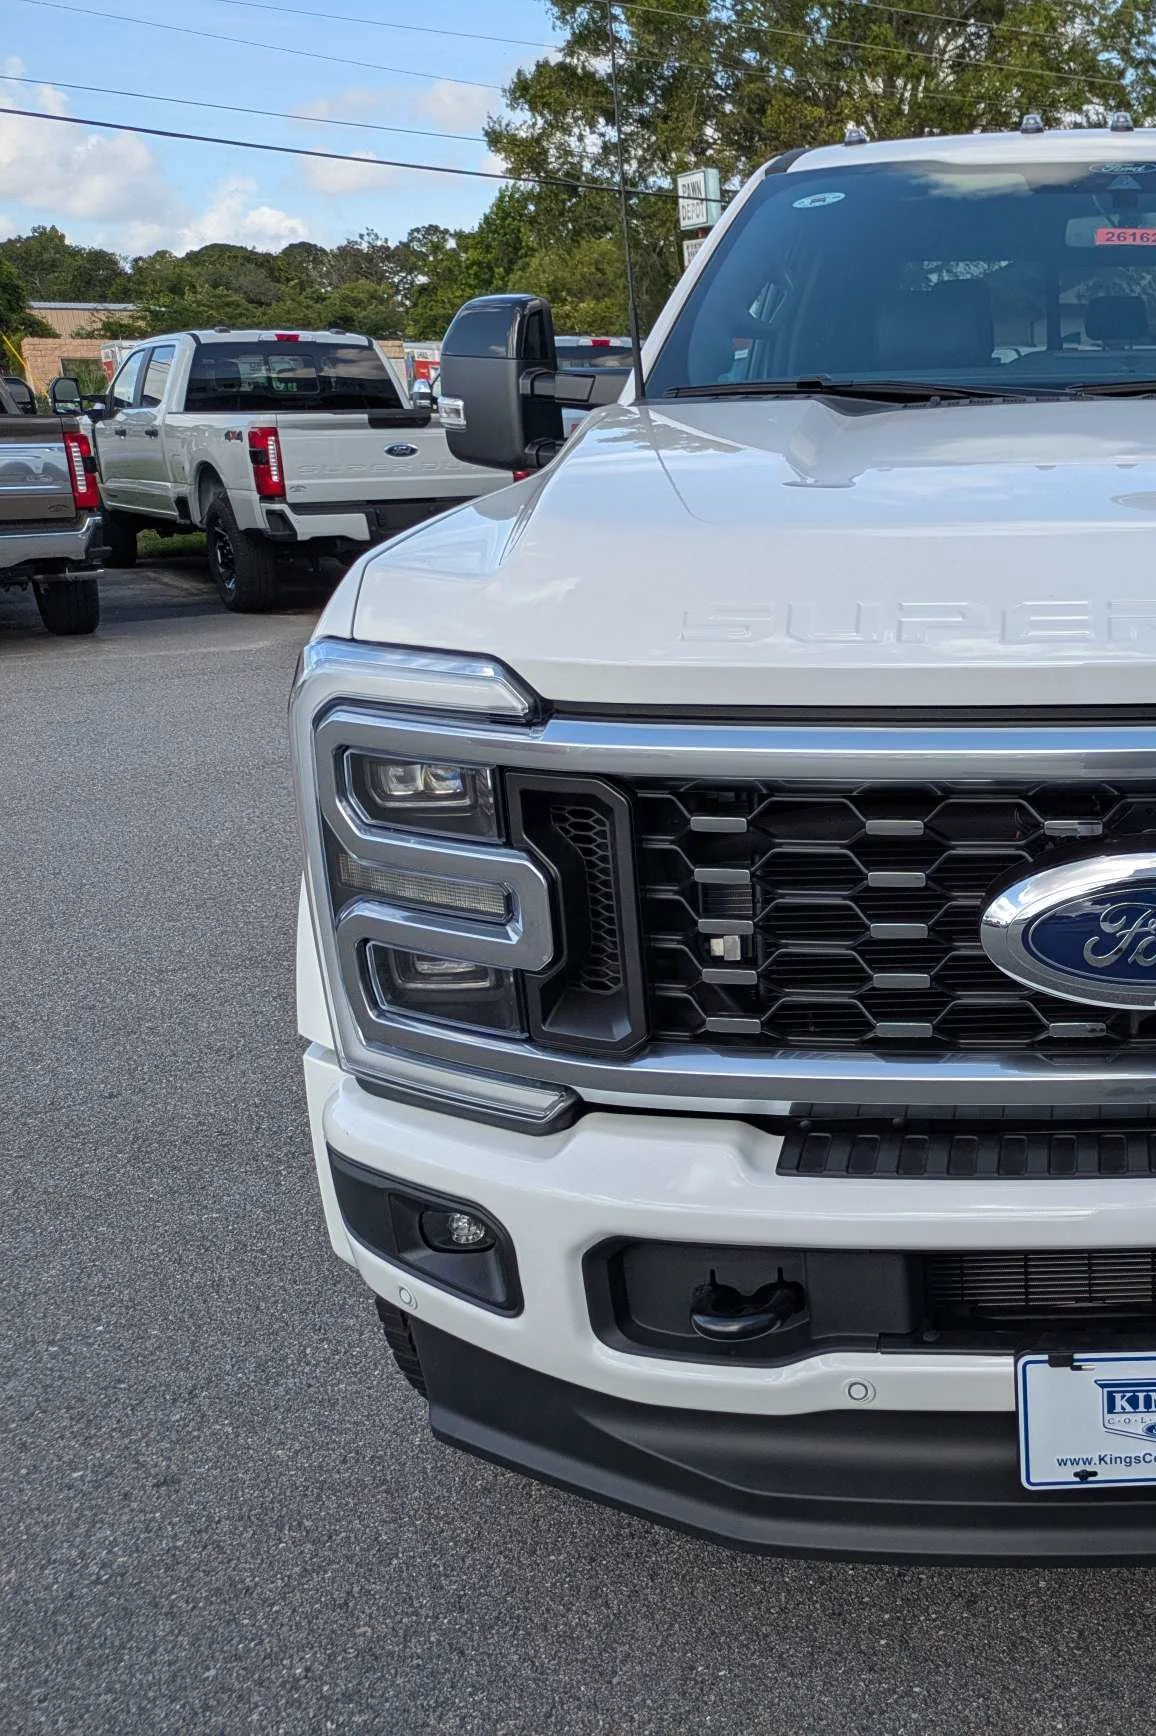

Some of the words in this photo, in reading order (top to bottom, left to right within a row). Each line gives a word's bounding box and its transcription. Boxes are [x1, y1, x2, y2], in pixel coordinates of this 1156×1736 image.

[1101, 162, 1146, 173] Ford
[682, 180, 703, 199] PAWN
[682, 201, 704, 221] DEPOT
